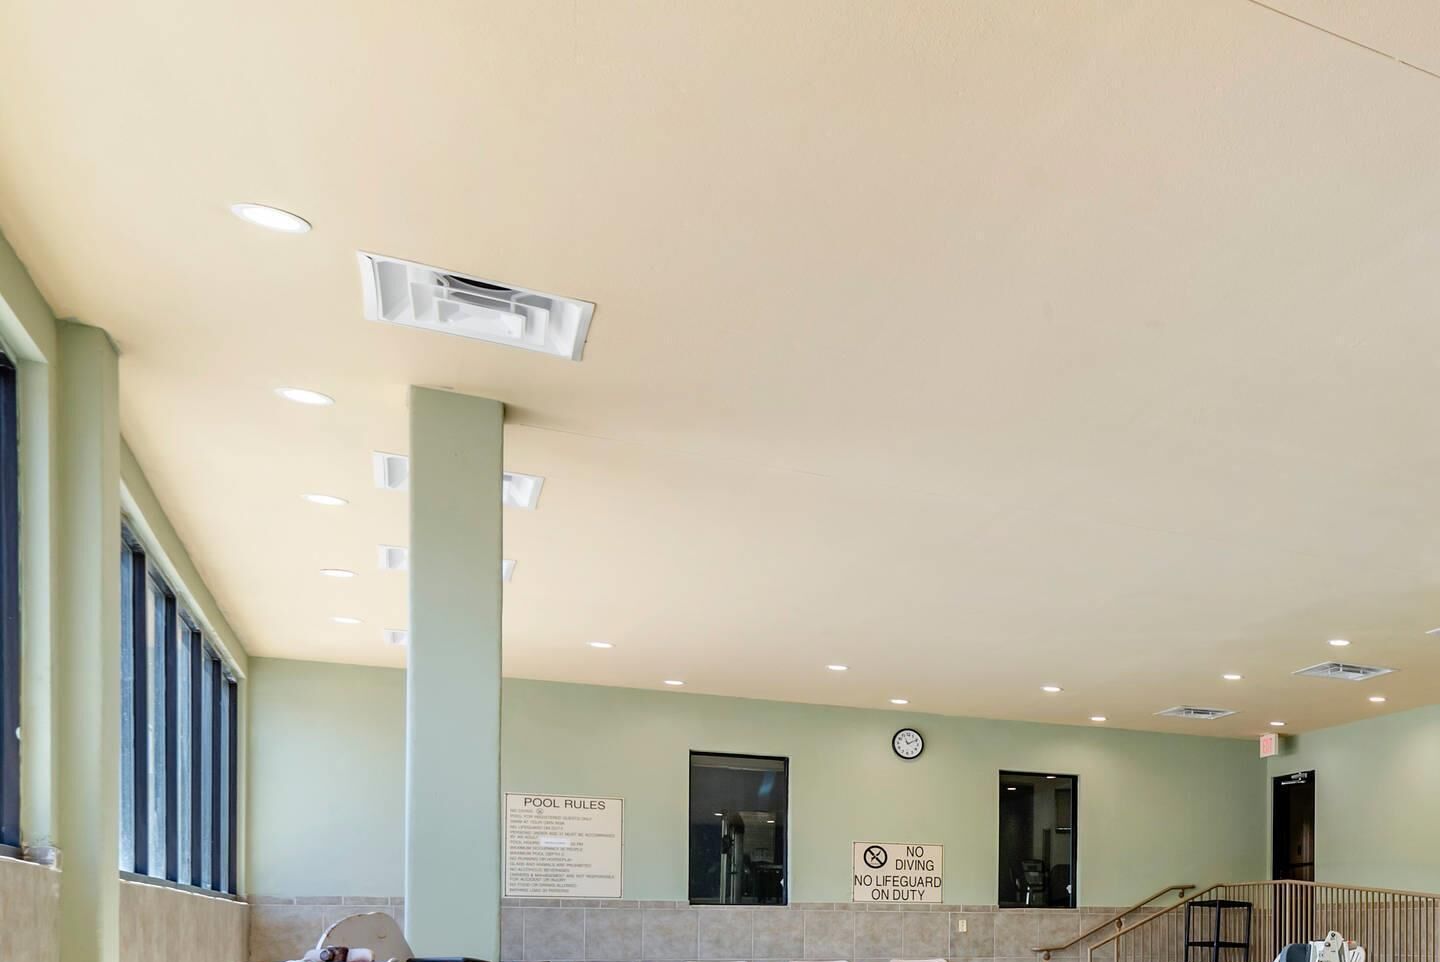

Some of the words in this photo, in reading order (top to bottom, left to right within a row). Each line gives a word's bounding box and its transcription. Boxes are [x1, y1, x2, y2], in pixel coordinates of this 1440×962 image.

[524, 798, 560, 808] POOL
[564, 799, 606, 810] RULES
[907, 846, 923, 857] NO
[896, 859, 934, 871] DIVING
[854, 875, 872, 886] NO
[876, 876, 941, 887] LIFEGUARD
[872, 889, 889, 900] ON
[893, 889, 925, 900] DUTY
